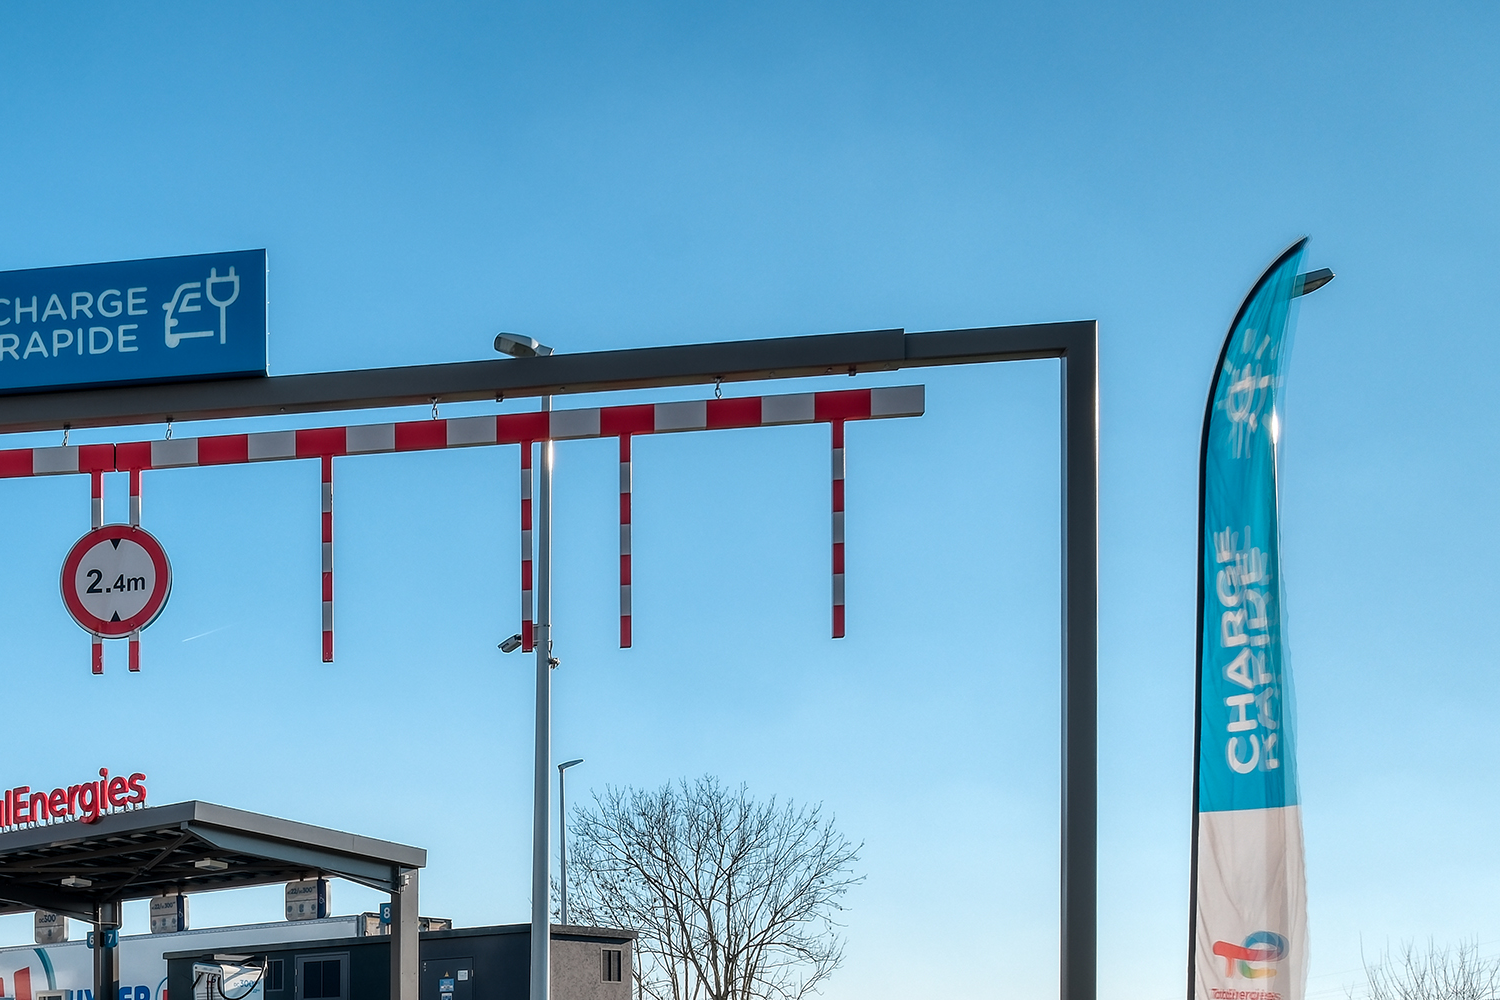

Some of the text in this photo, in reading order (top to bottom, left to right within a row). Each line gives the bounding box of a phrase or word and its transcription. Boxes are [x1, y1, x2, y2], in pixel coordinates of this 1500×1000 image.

[86, 568, 145, 594] 2.4m
[1214, 526, 1260, 774] CHARGE
[383, 907, 390, 919] 8
[107, 933, 113, 944] 7
